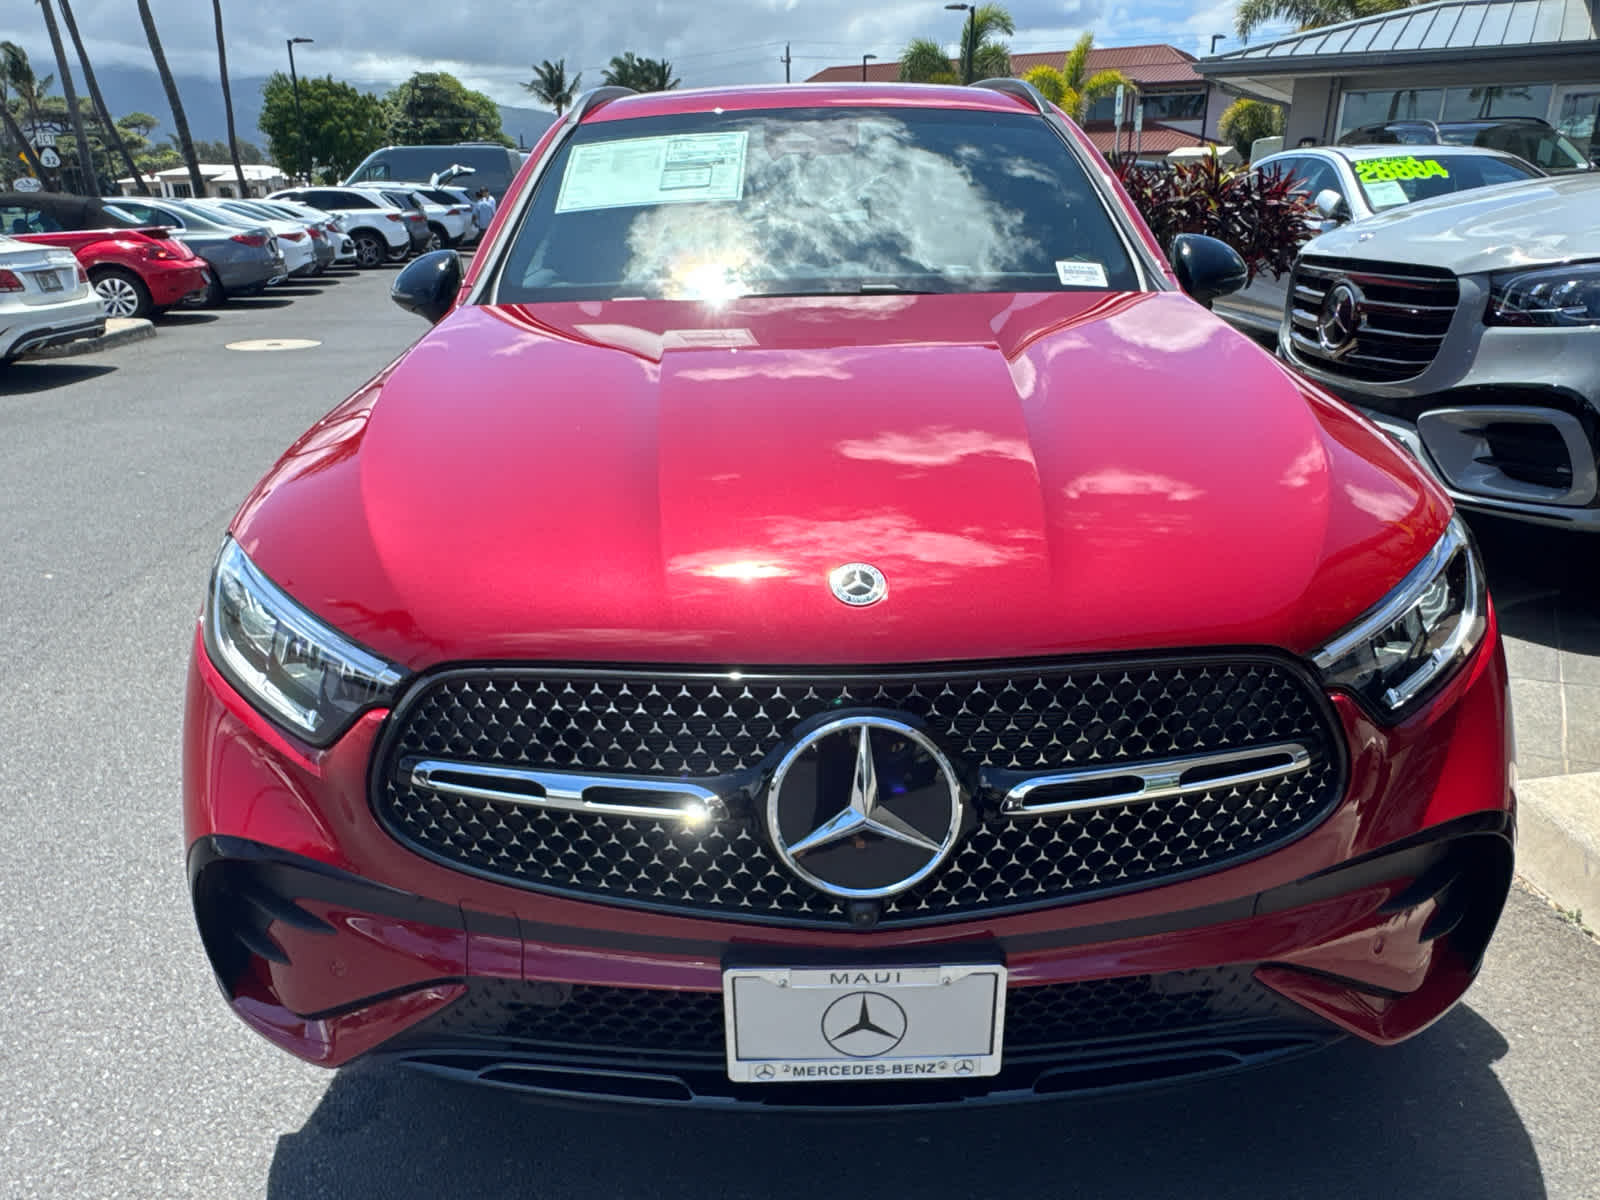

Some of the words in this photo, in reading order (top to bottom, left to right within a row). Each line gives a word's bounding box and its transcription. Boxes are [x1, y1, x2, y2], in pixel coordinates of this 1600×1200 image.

[44, 156, 57, 165] 32
[830, 972, 900, 984] MAUI
[792, 1063, 937, 1076] MERCEDES-BENZ
